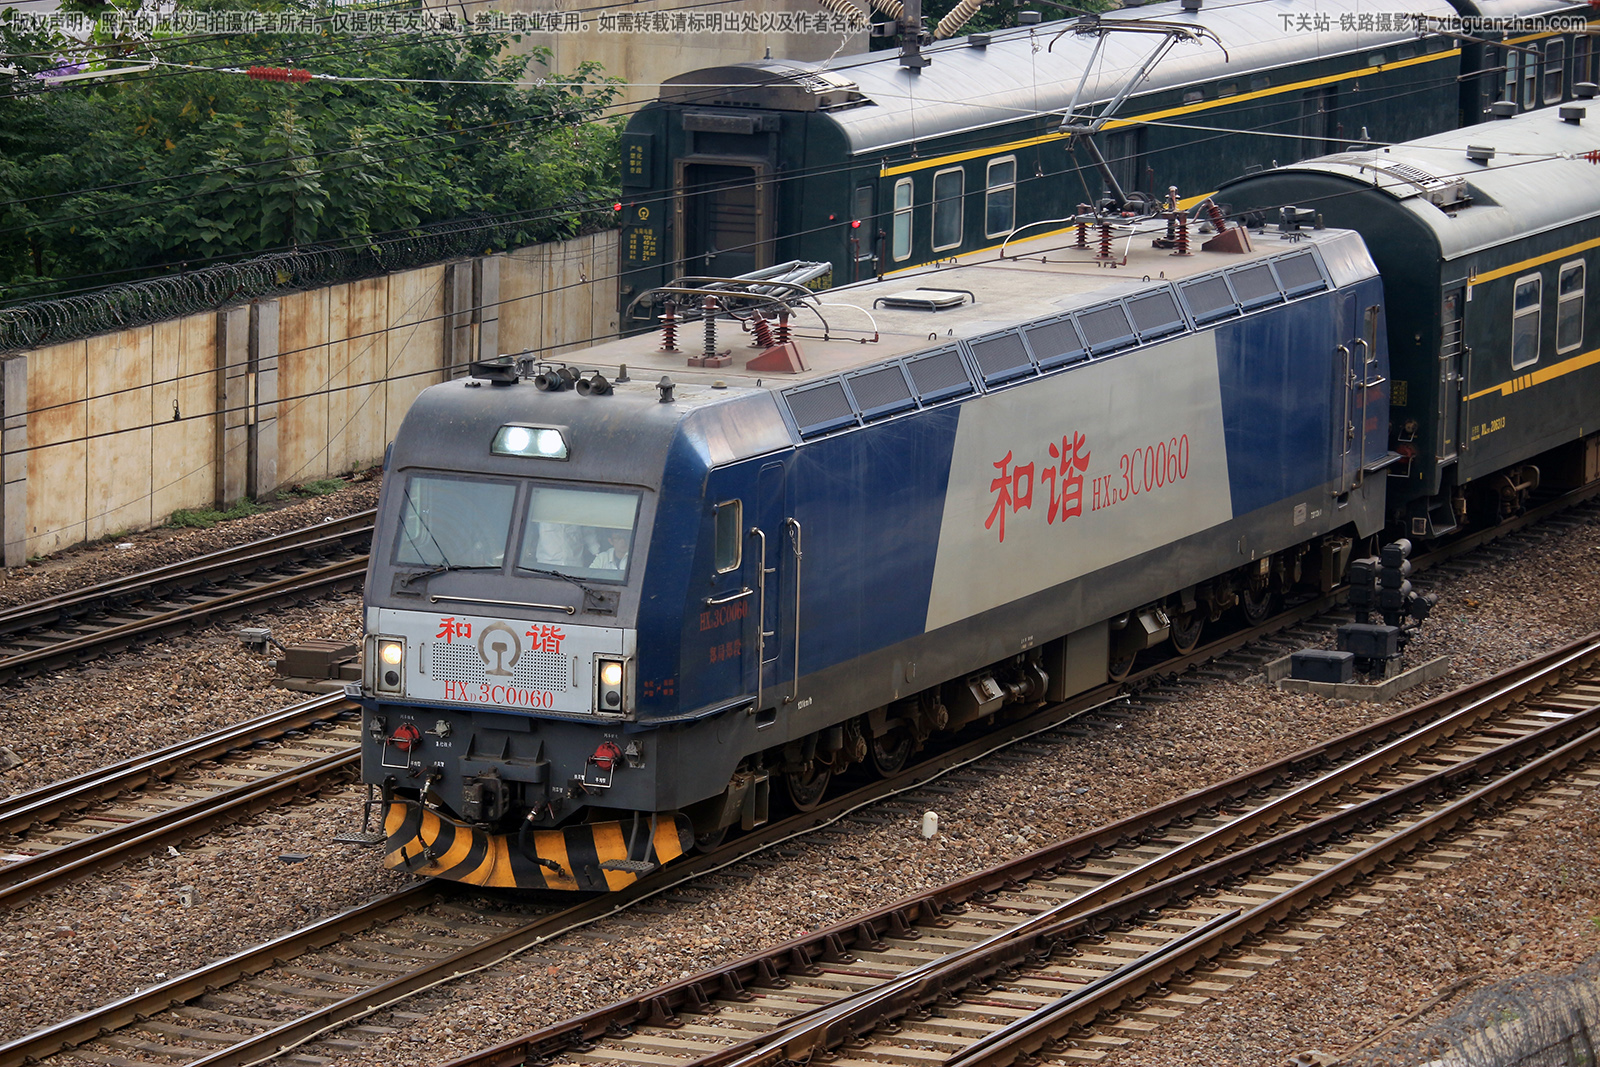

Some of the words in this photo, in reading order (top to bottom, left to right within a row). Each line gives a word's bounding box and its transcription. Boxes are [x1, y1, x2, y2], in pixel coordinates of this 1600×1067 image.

[984, 430, 1091, 543] 和谐
[435, 616, 472, 644] 和
[525, 624, 566, 654] 谐
[443, 680, 554, 709] HXD3C0060
